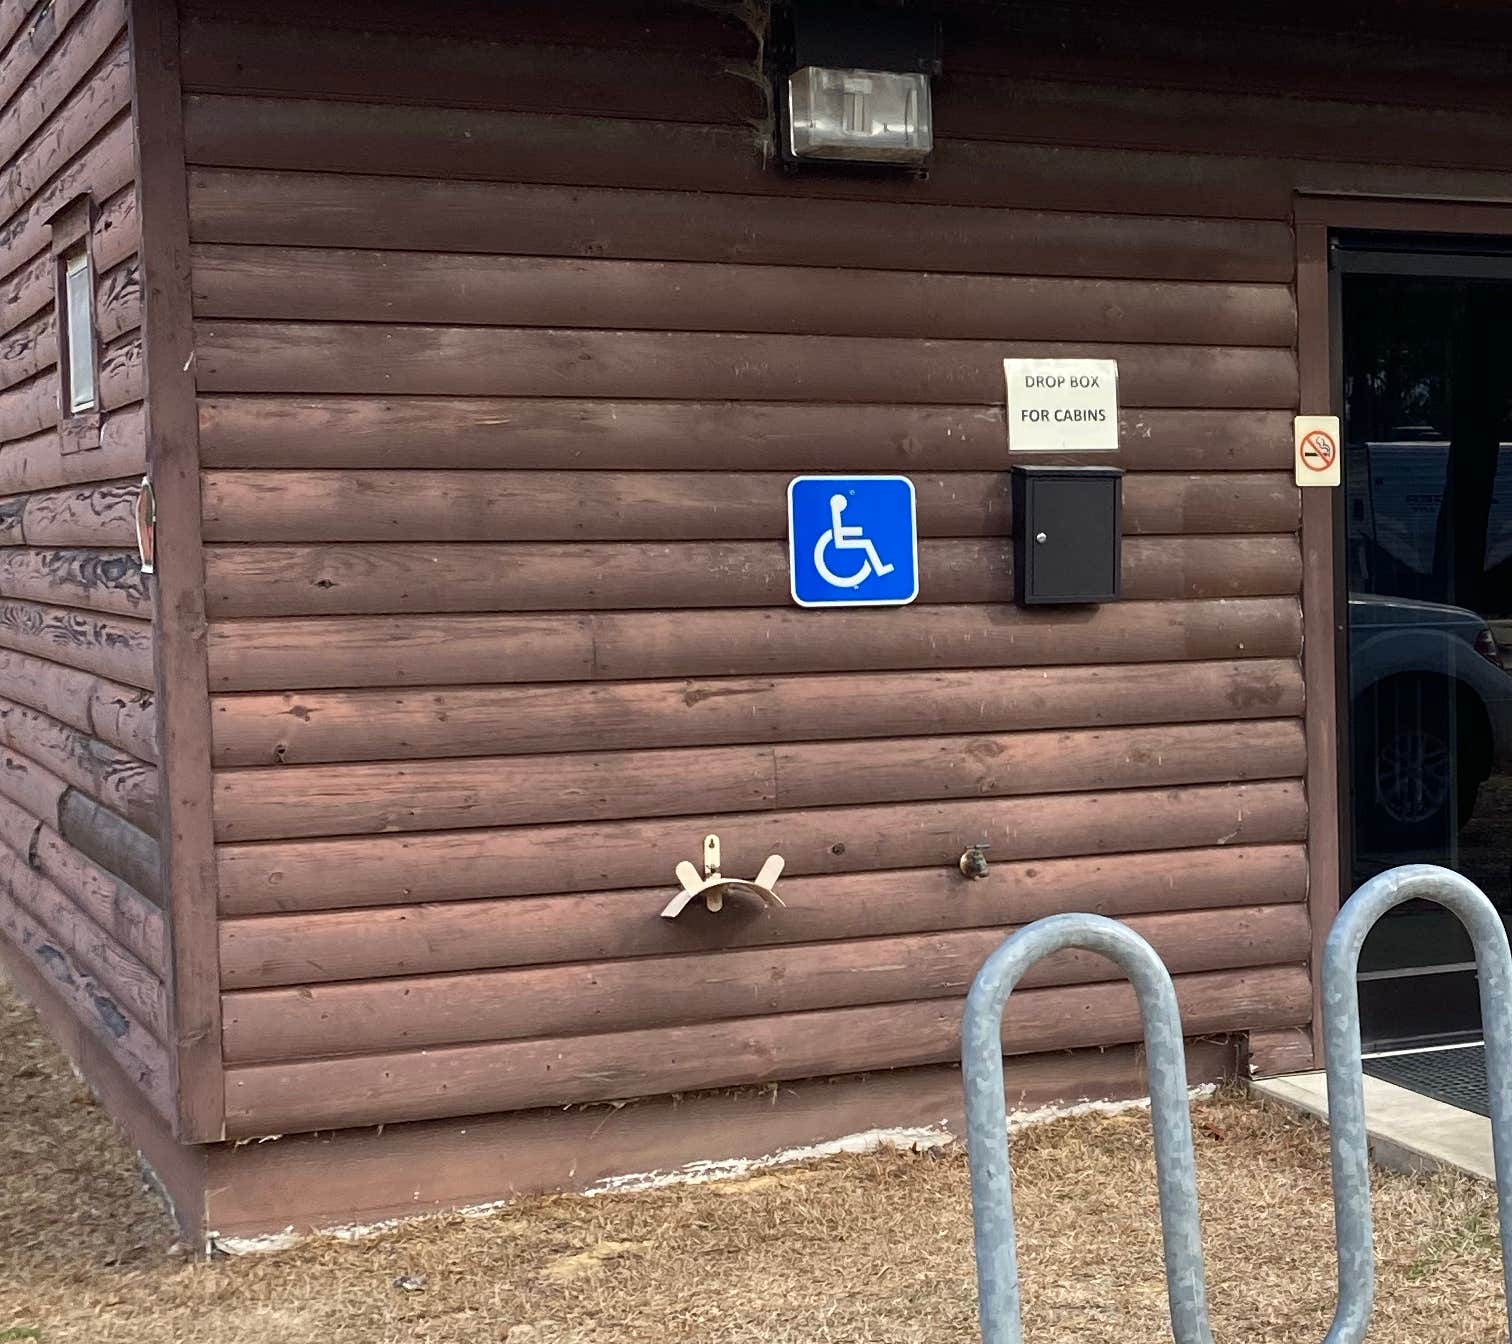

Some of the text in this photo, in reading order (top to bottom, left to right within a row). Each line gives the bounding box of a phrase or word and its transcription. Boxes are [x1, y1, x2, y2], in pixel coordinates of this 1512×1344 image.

[1025, 375, 1100, 388] DROP BOX
[1021, 409, 1106, 422] FOR CABINS
